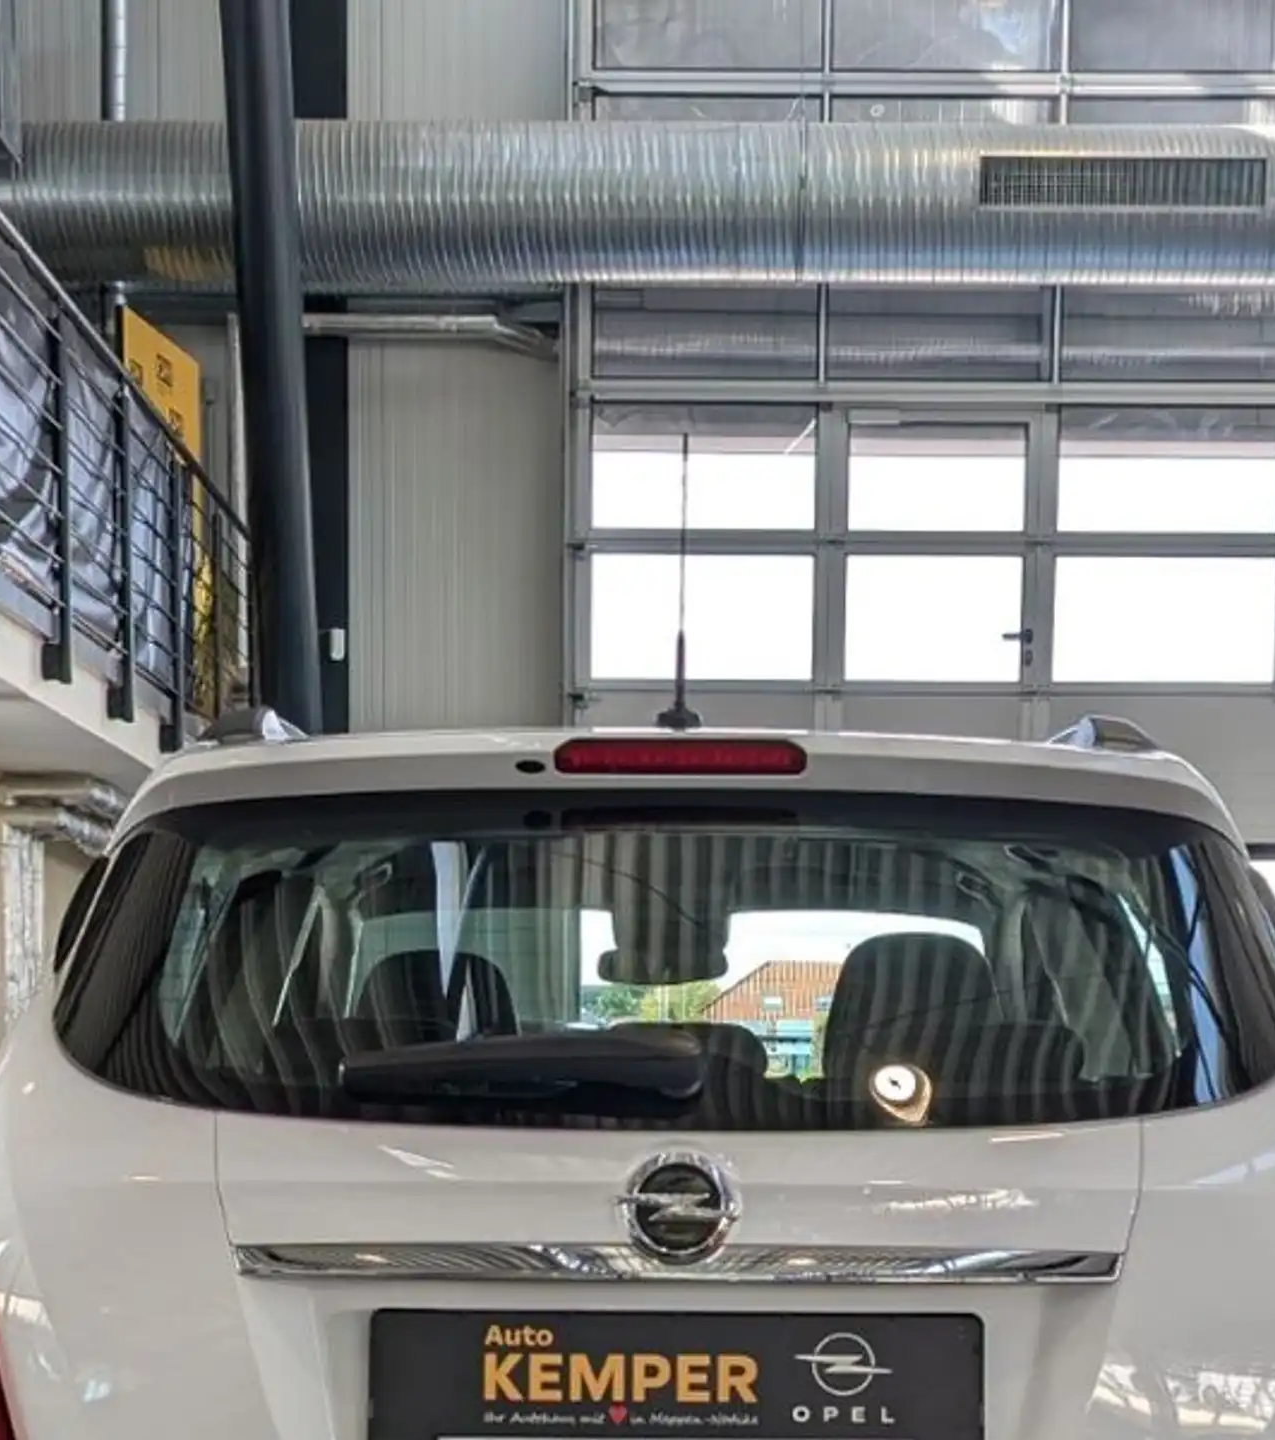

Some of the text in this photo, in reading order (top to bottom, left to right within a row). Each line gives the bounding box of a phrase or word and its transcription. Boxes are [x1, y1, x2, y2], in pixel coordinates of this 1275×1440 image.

[484, 1325, 554, 1347] Auto
[483, 1353, 759, 1403] KEMPER
[792, 1405, 896, 1424] OPEL
